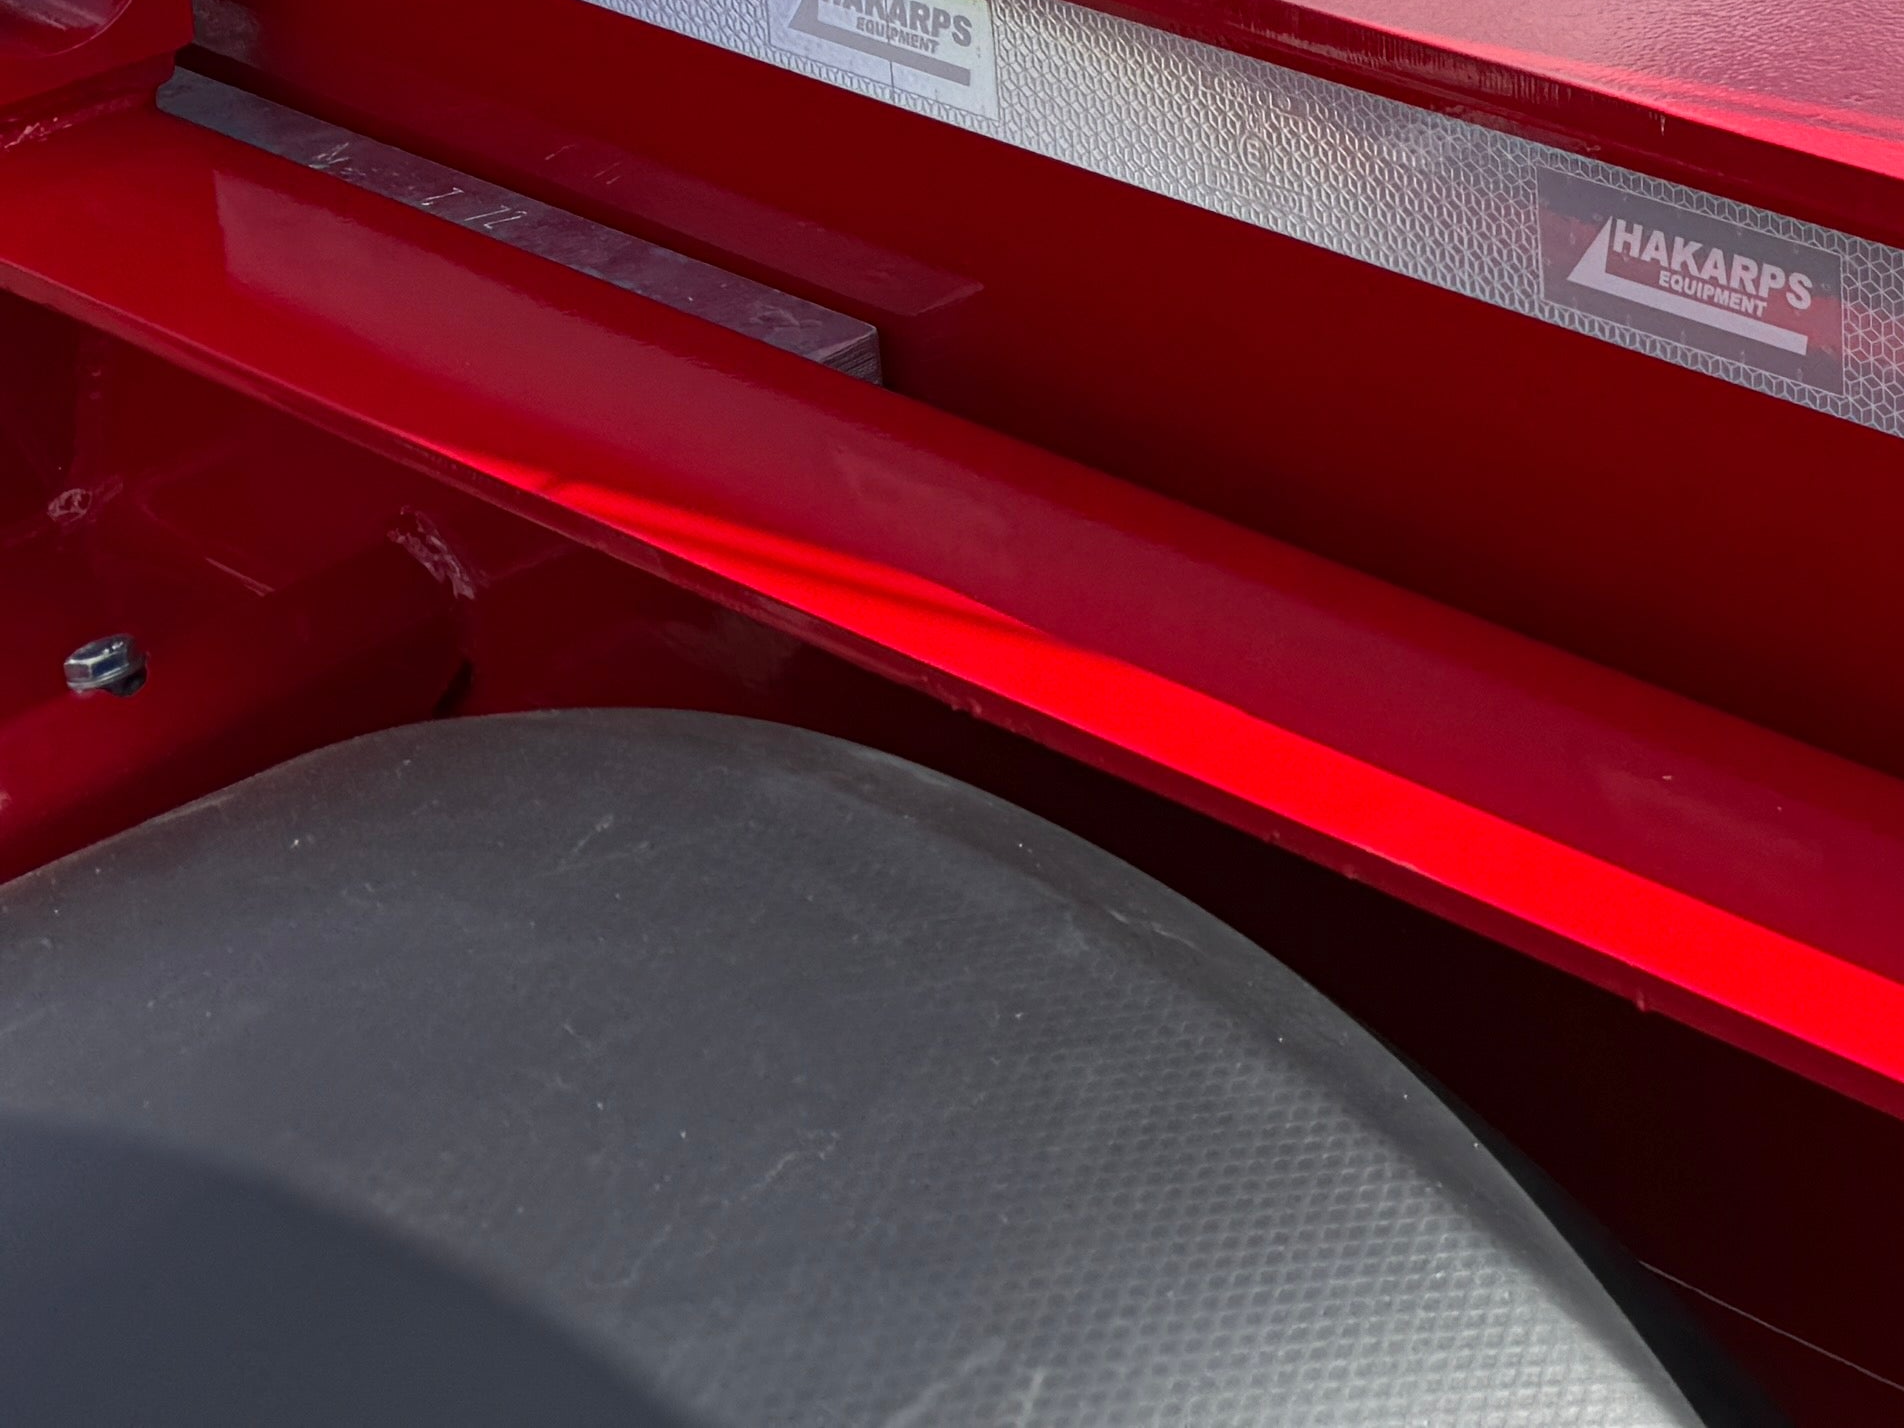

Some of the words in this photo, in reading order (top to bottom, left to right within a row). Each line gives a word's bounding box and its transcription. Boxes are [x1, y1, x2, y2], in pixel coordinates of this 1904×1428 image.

[856, 17, 940, 54] EQUIPMENT
[1612, 218, 1813, 311] HAKARPS
[1658, 270, 1768, 318] EQUIPMENT
